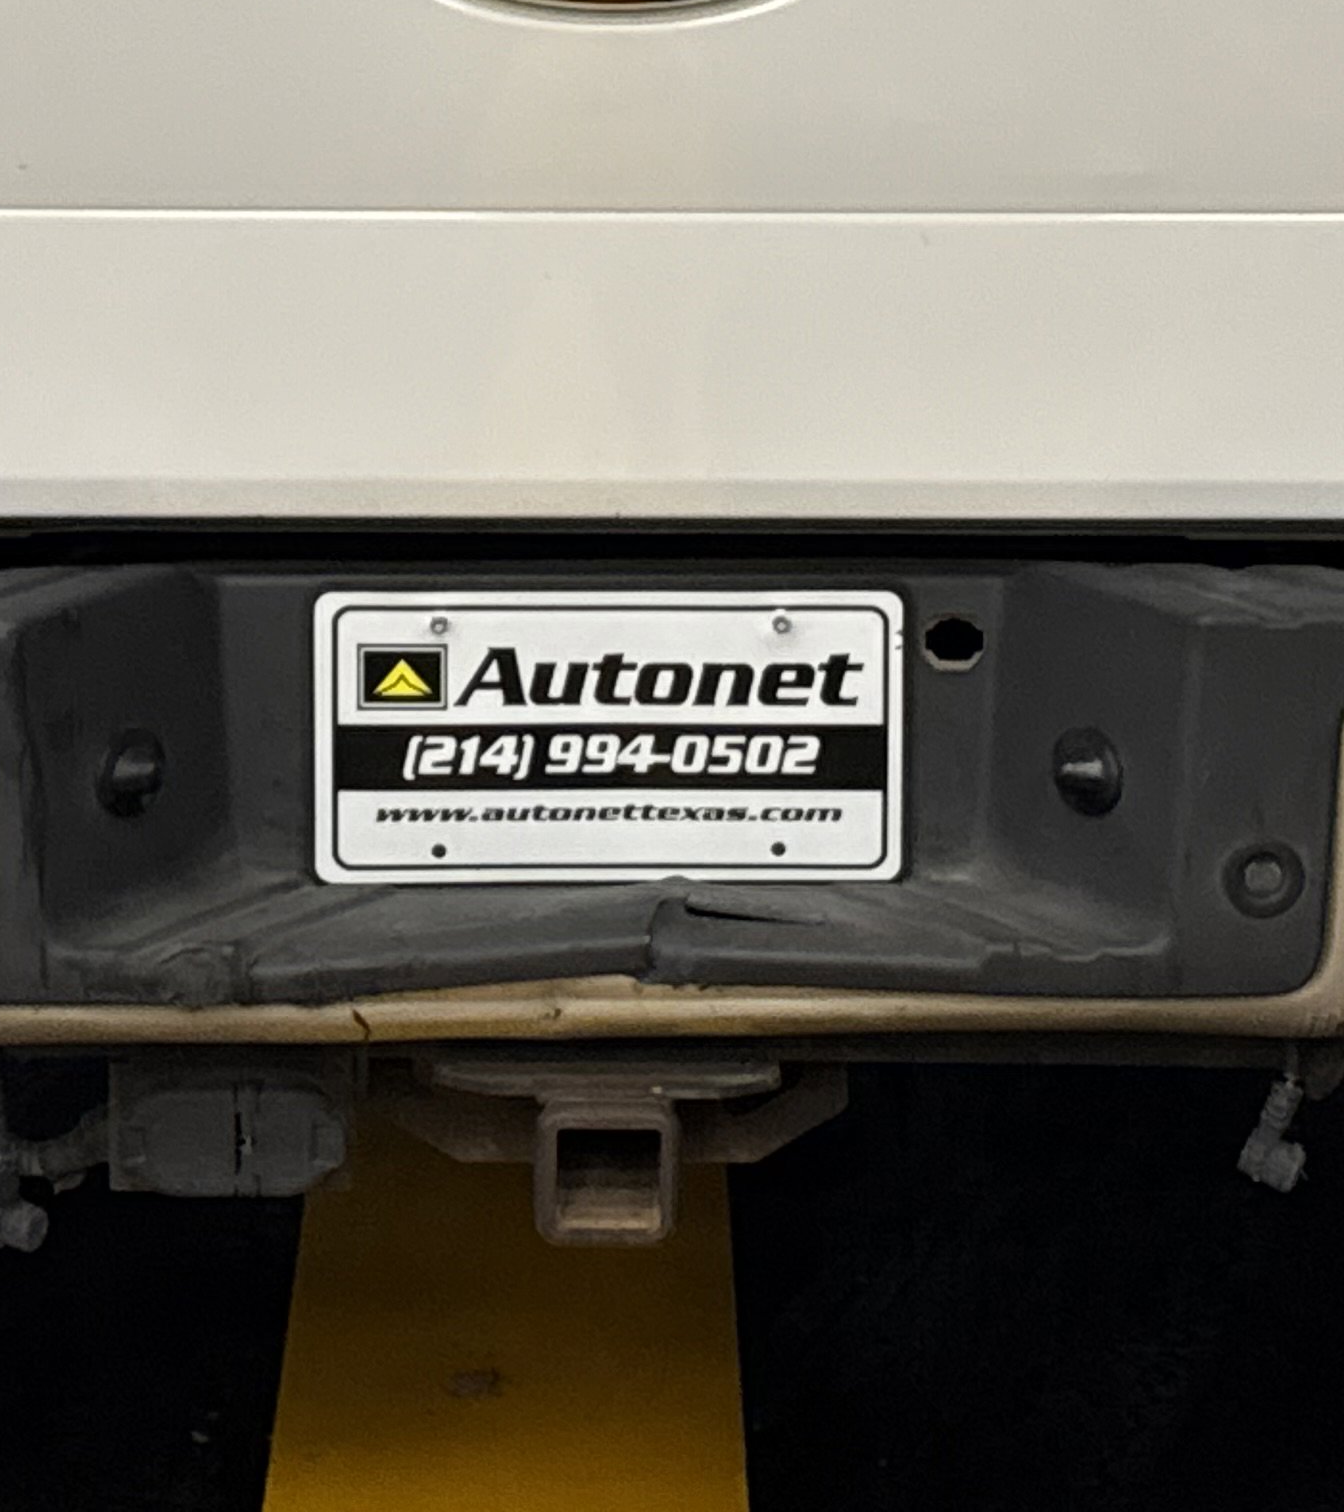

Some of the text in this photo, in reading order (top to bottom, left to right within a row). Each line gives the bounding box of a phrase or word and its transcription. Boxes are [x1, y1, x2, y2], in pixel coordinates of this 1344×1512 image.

[455, 646, 864, 707] Autonet
[402, 734, 820, 780] (214) 994-0502
[376, 803, 842, 822] www.autonettexas.com
